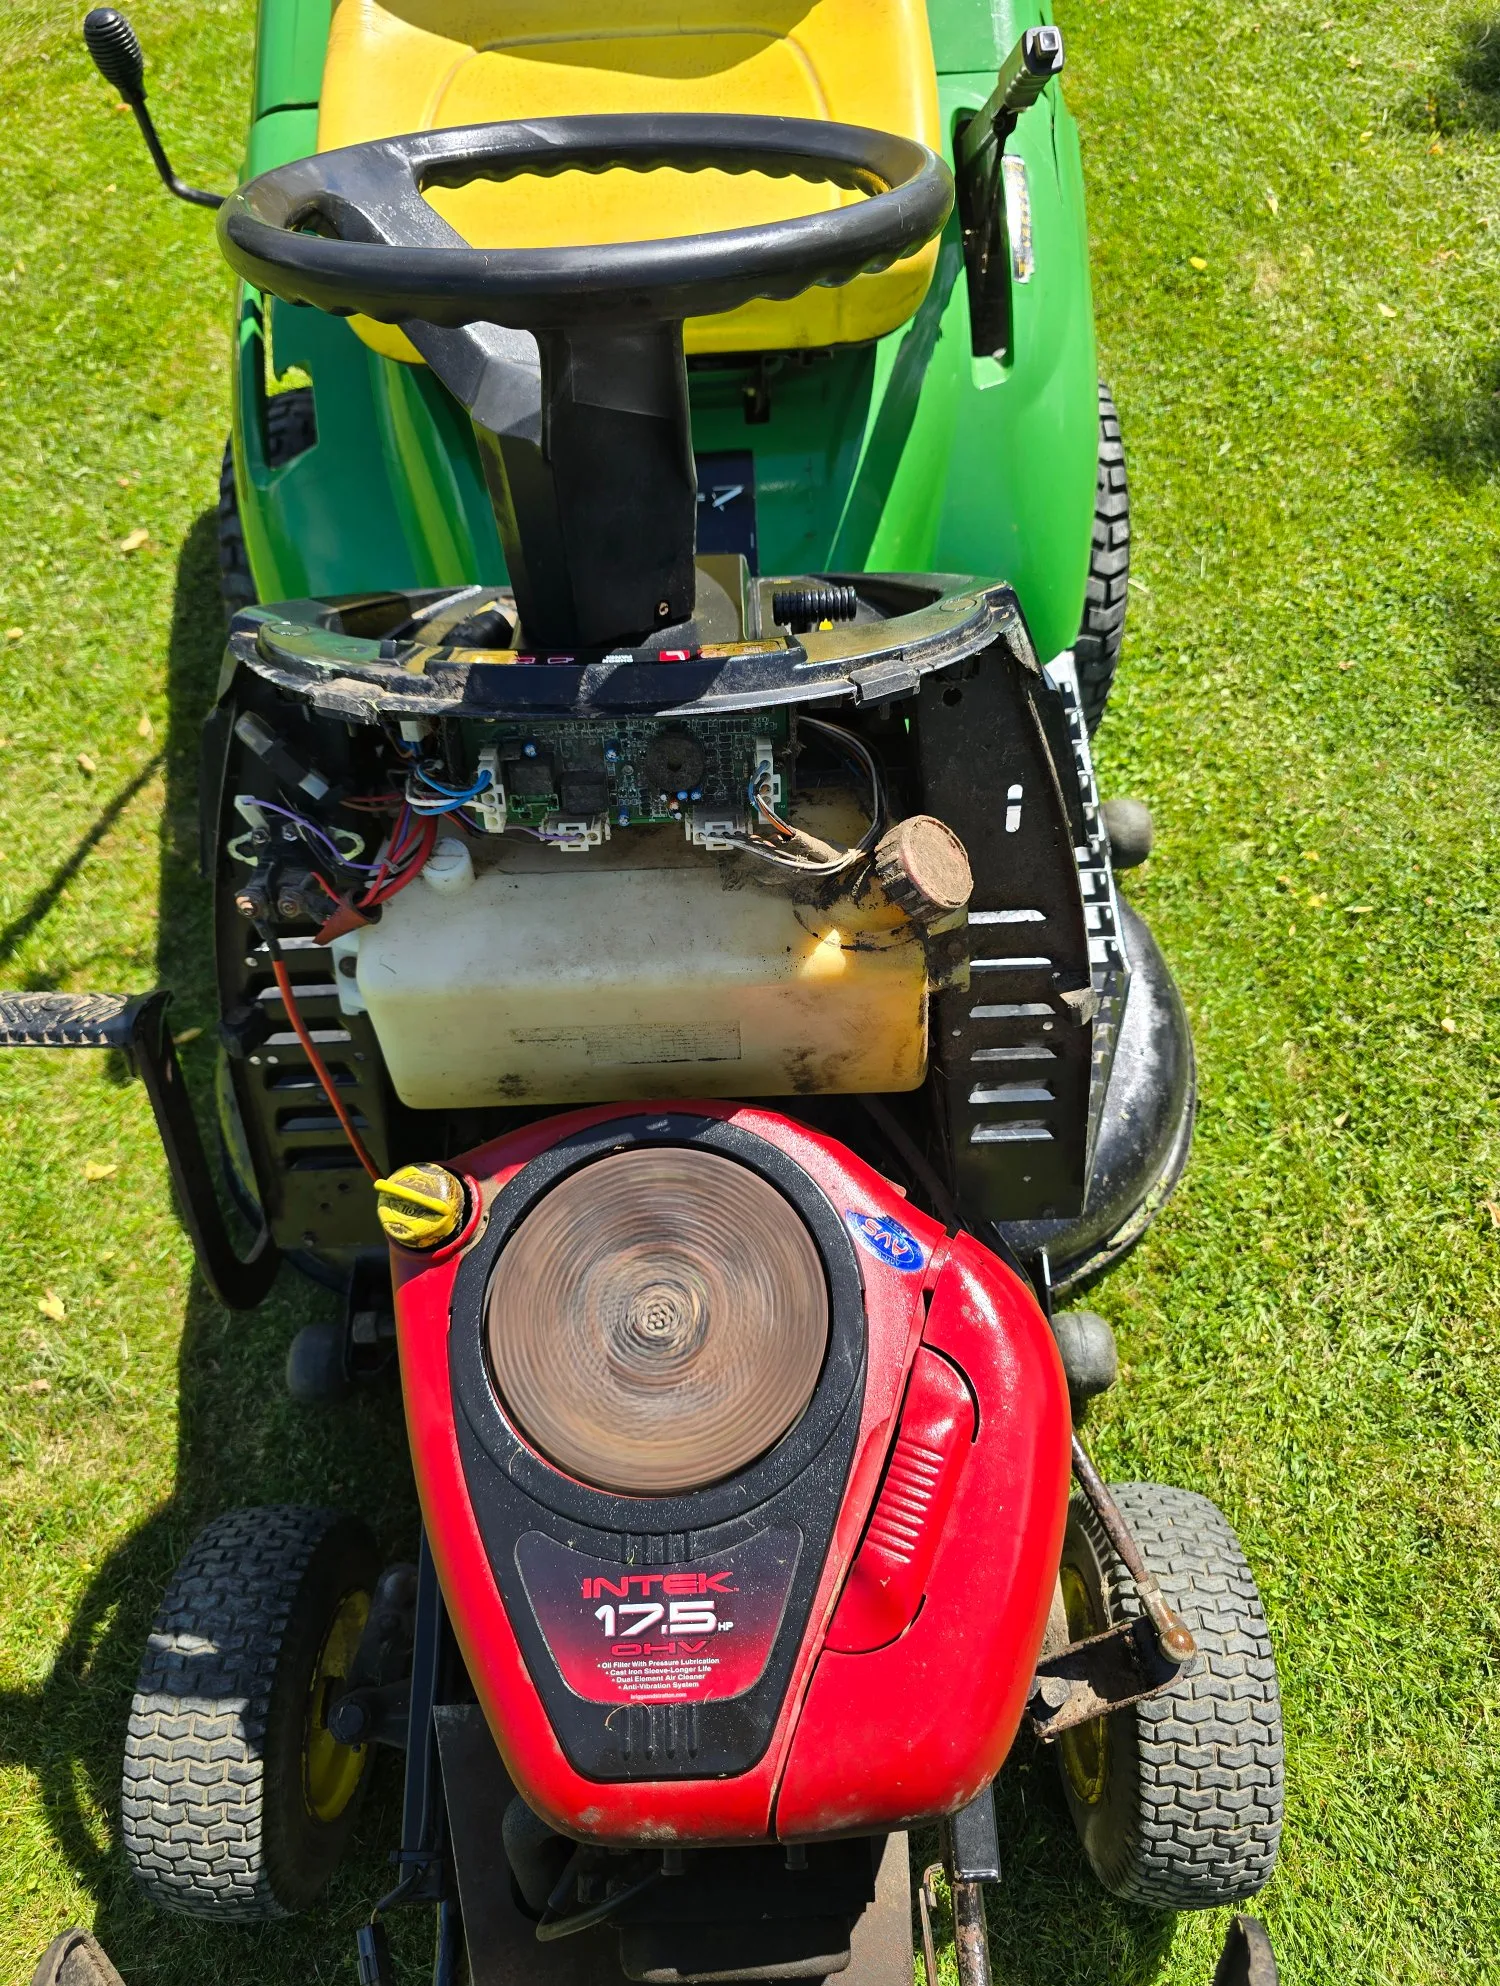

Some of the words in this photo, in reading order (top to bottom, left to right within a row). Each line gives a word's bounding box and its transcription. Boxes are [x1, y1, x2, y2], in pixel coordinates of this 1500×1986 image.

[860, 1217, 910, 1256] AVS
[594, 1600, 718, 1637] 17.5
[718, 1620, 734, 1632] HP
[611, 1640, 709, 1656] OHV
[602, 1661, 612, 1669] Oil
[648, 1659, 680, 1667] Pressure
[680, 1657, 720, 1666] Lubrication
[623, 1682, 671, 1691] Anti-Vibration
[672, 1681, 700, 1689] System
